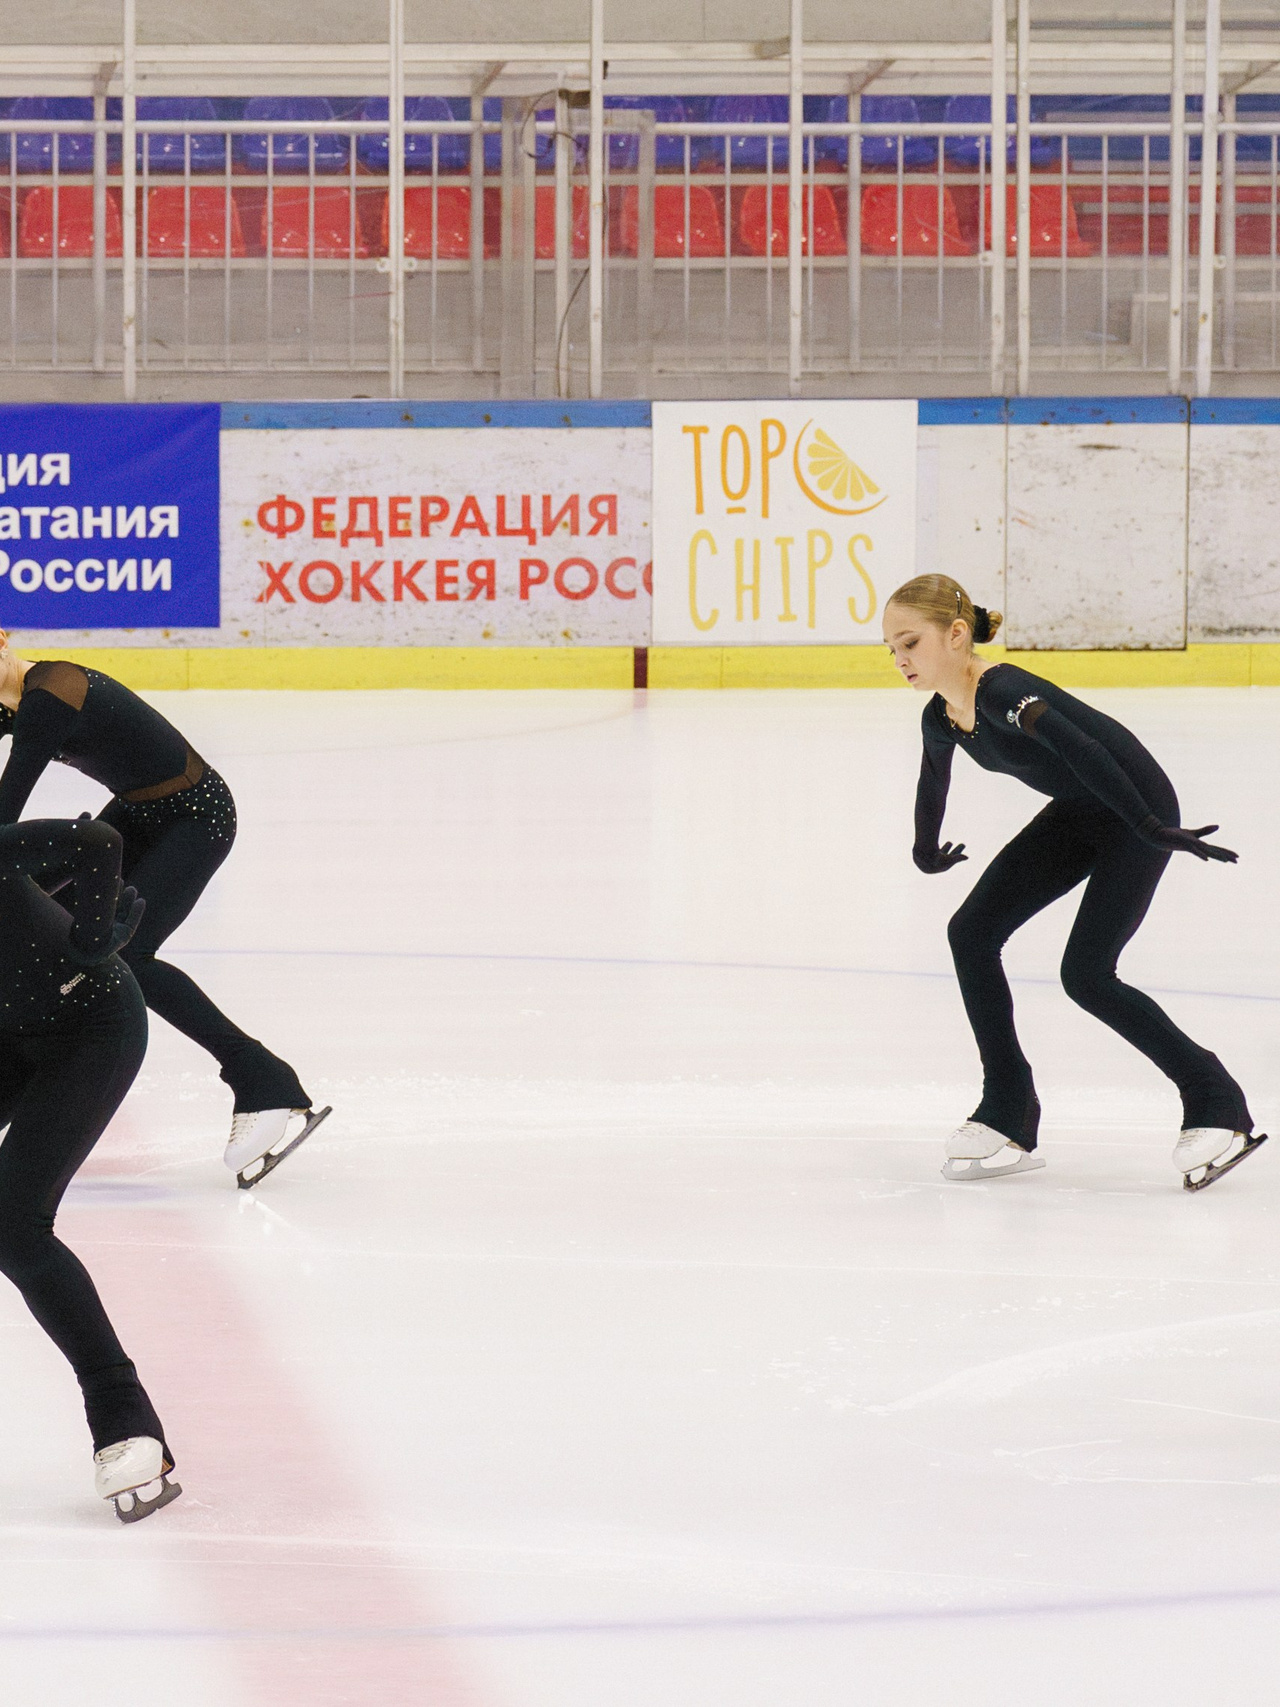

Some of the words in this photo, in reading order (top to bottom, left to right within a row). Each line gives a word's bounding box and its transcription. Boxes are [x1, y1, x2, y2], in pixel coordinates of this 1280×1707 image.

[681, 418, 787, 519] TOP
[256, 494, 618, 548] ФЕДЕРАЦИЯ
[256, 558, 497, 604] ХОККЕЯ
[518, 557, 652, 601] РОС
[688, 528, 878, 632] CHIPS
